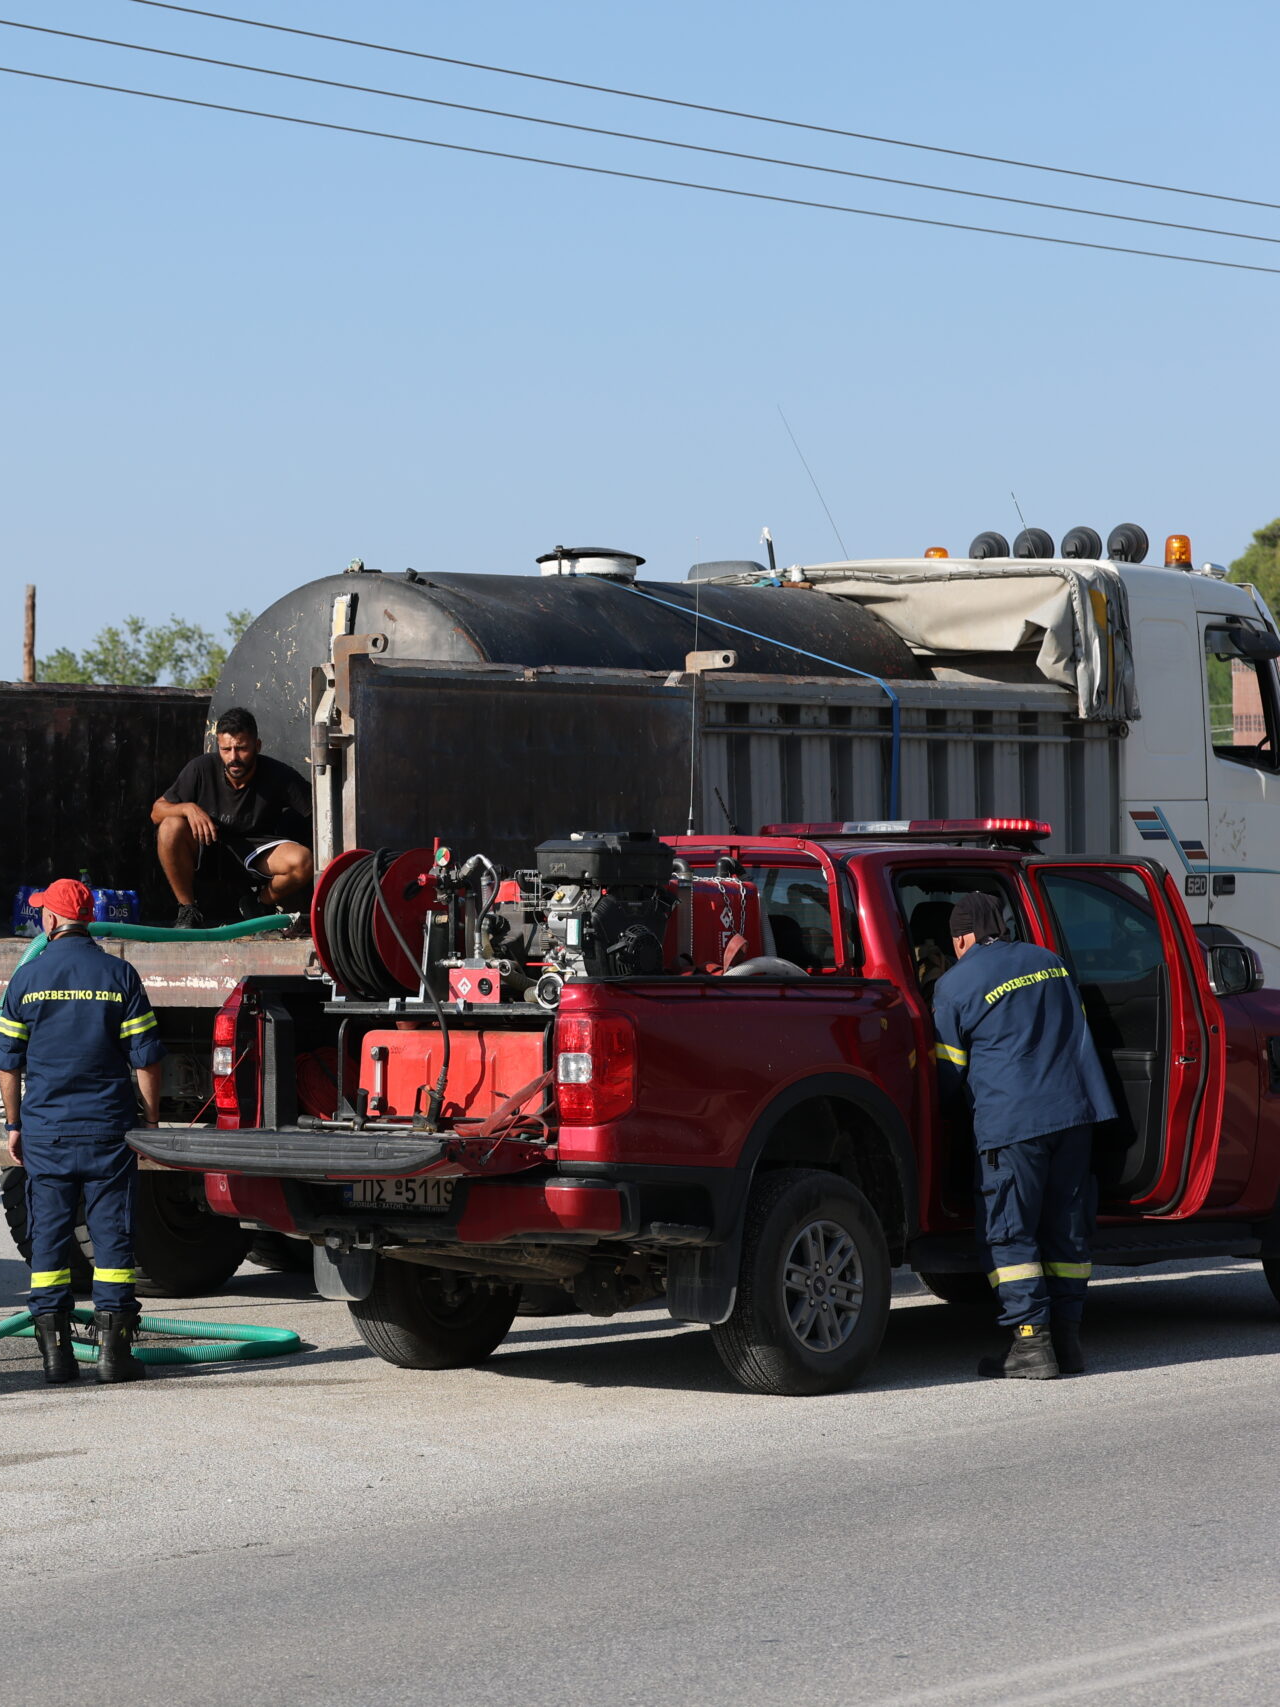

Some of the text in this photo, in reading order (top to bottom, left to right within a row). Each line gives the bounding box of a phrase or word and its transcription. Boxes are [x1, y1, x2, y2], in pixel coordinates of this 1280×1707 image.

[1188, 878, 1206, 894] 520
[109, 904, 129, 918] Dios
[985, 970, 1049, 1005] ΠΥΡΟΣΒΕΣΤΙΚΟ
[22, 990, 93, 1005] ΠΥΡΟΣΒΕΣΤΙΚΟ
